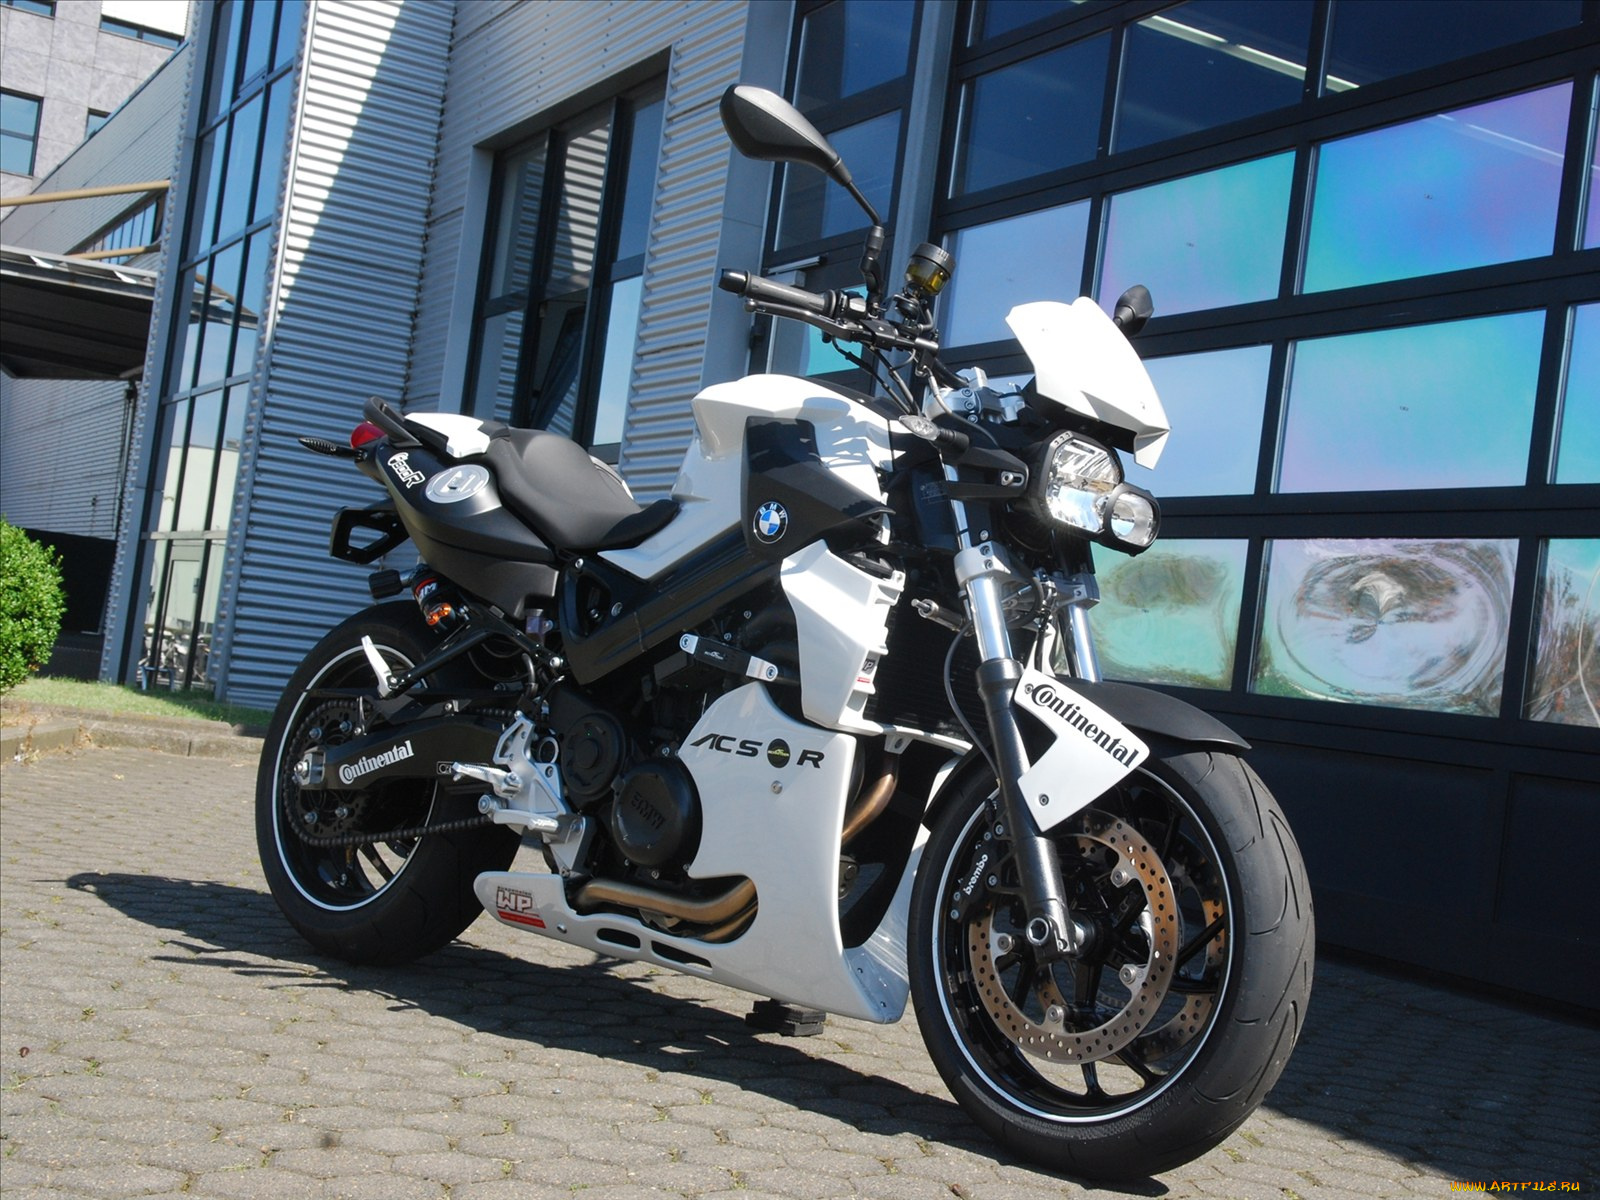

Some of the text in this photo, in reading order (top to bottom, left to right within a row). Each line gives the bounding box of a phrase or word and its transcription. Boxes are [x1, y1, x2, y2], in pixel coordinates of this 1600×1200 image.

[759, 503, 787, 519] BMW
[1031, 684, 1139, 768] Continental
[338, 740, 415, 785] Continental
[796, 749, 825, 769] R
[963, 853, 989, 896] brembo
[496, 889, 533, 913] WP
